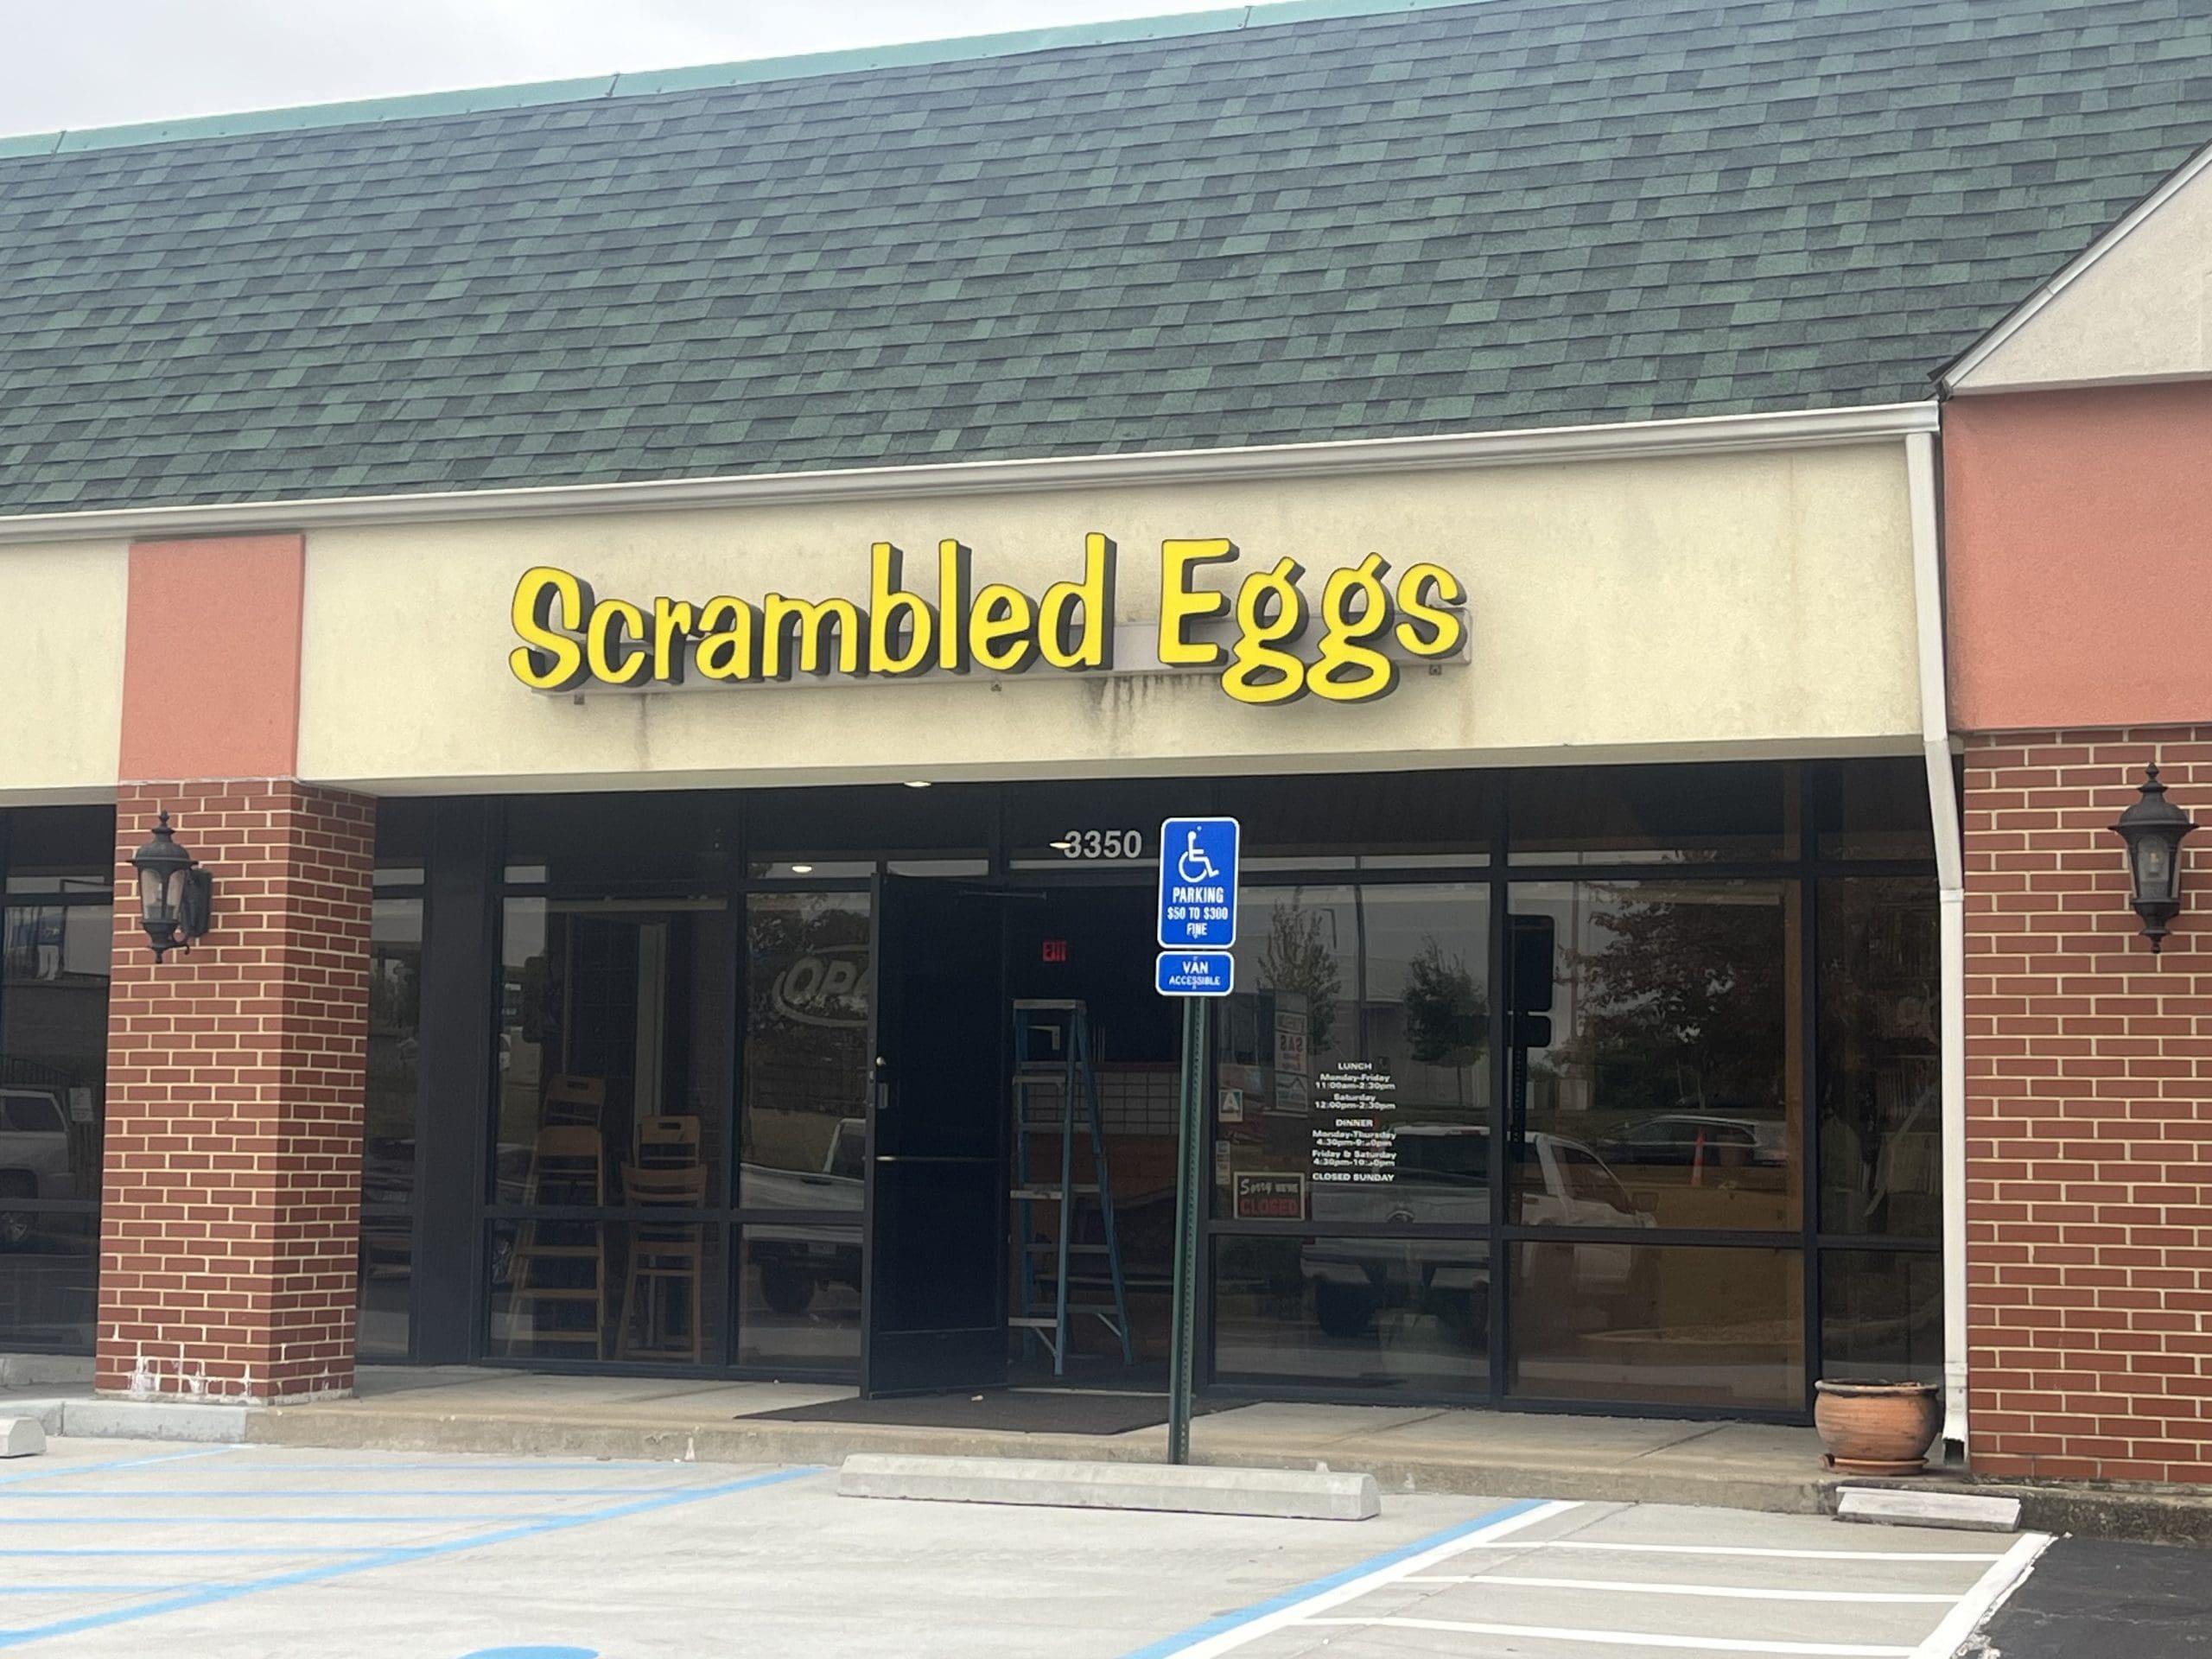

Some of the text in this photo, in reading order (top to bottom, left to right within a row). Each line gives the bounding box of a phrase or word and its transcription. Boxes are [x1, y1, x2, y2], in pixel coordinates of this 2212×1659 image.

[509, 532, 1467, 703] Scrambled Eggs
[1064, 830, 1142, 858] 3350
[1173, 887, 1224, 904] PARKING
[1167, 906, 1229, 920] $50 TO $300
[1186, 923, 1207, 936] FINE
[1182, 961, 1208, 974] VAN
[1169, 976, 1220, 986] ACCESSIBLE
[1338, 1062, 1372, 1071] LUNCH
[1320, 1073, 1390, 1083] Monday-Friday
[1333, 1093, 1376, 1102] Saturday
[1312, 1150, 1341, 1159] Friday
[1354, 1151, 1397, 1160] Saturday
[1313, 1173, 1395, 1182] CLOSED SUNDAY
[1240, 1178, 1273, 1195] Sorry
[1240, 1198, 1298, 1216] CLOSED
